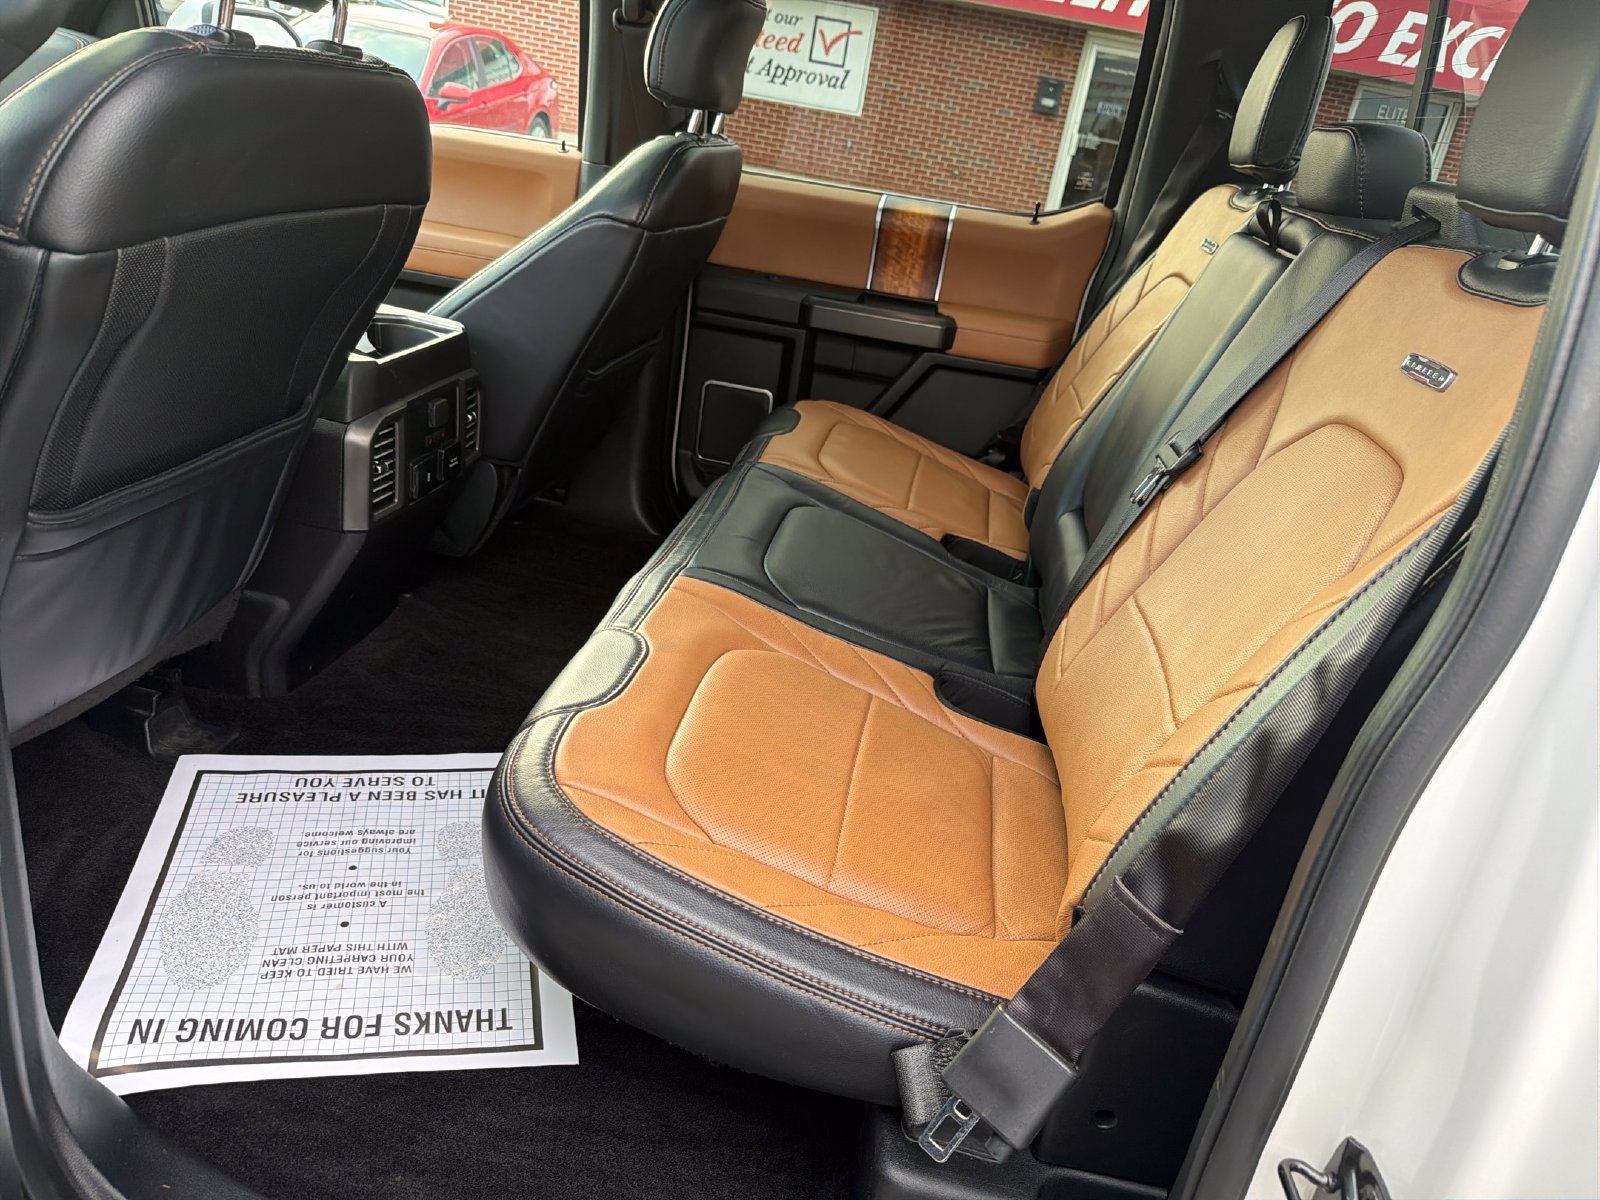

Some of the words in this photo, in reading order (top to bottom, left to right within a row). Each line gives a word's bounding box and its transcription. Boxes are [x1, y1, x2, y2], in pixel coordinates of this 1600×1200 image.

[774, 12, 803, 27] our
[1377, 11, 1506, 81] EXC
[756, 58, 851, 90] Approval
[295, 777, 335, 788] YOU
[343, 776, 405, 788] SERVE
[412, 776, 436, 787] TO
[235, 791, 341, 803] PLEASURE
[349, 791, 361, 801] A
[368, 790, 417, 801] BEEN
[424, 789, 462, 800] HAS
[469, 788, 485, 799] IT
[301, 829, 354, 838] welcome.
[296, 839, 336, 847] service
[361, 838, 416, 846] improving
[298, 849, 314, 858] for
[317, 847, 383, 857] suggestions
[387, 847, 411, 855] Your
[333, 881, 366, 889] world
[271, 892, 311, 902] person
[315, 890, 371, 900] important
[375, 889, 403, 897] most
[321, 901, 376, 909] customer
[272, 946, 297, 956] MAT
[302, 944, 341, 952] PAPER
[346, 943, 372, 951] THIS
[377, 942, 408, 951] WITH
[262, 957, 303, 968] CLEAN
[307, 954, 376, 965] CARPETING
[380, 953, 414, 962] YOUR
[260, 970, 292, 979] KEEP
[297, 968, 313, 977] TO
[317, 966, 354, 976] TRIED
[358, 965, 389, 974] HAVE
[393, 965, 412, 974] WE
[321, 1014, 382, 1039] FOR
[395, 1008, 513, 1035] THANKS
[127, 1018, 166, 1044] IN
[175, 1018, 309, 1042] COMING
